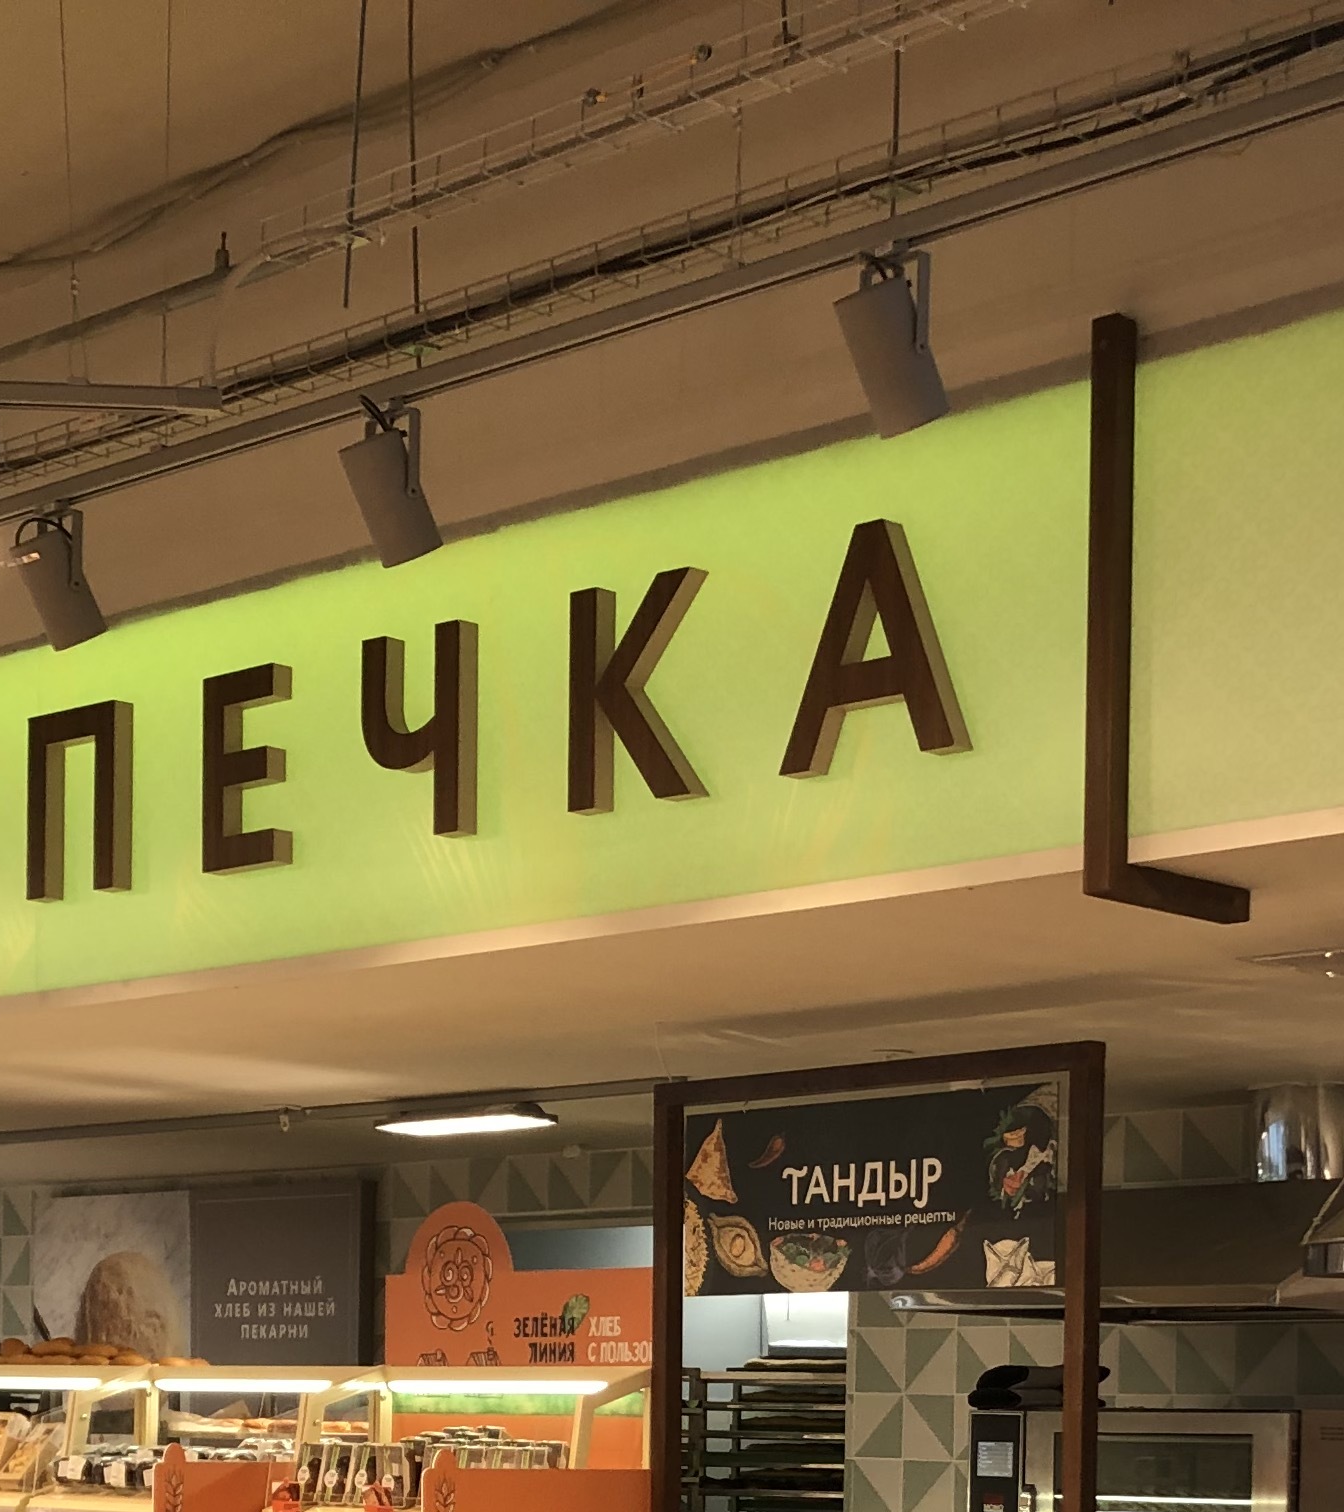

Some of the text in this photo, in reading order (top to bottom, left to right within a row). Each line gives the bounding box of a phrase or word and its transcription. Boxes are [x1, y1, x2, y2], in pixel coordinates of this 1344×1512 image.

[781, 1157, 943, 1209] ТАНДЫР
[768, 1211, 956, 1231] Новые и традиционные рецепты
[240, 1324, 309, 1339] ПЕКАРНИ
[513, 1312, 576, 1338] ЗЕЛЁНАЯ
[588, 1316, 621, 1337] ХЛЕБ
[528, 1341, 575, 1363] ЛИНИЯ
[587, 1342, 597, 1362] С
